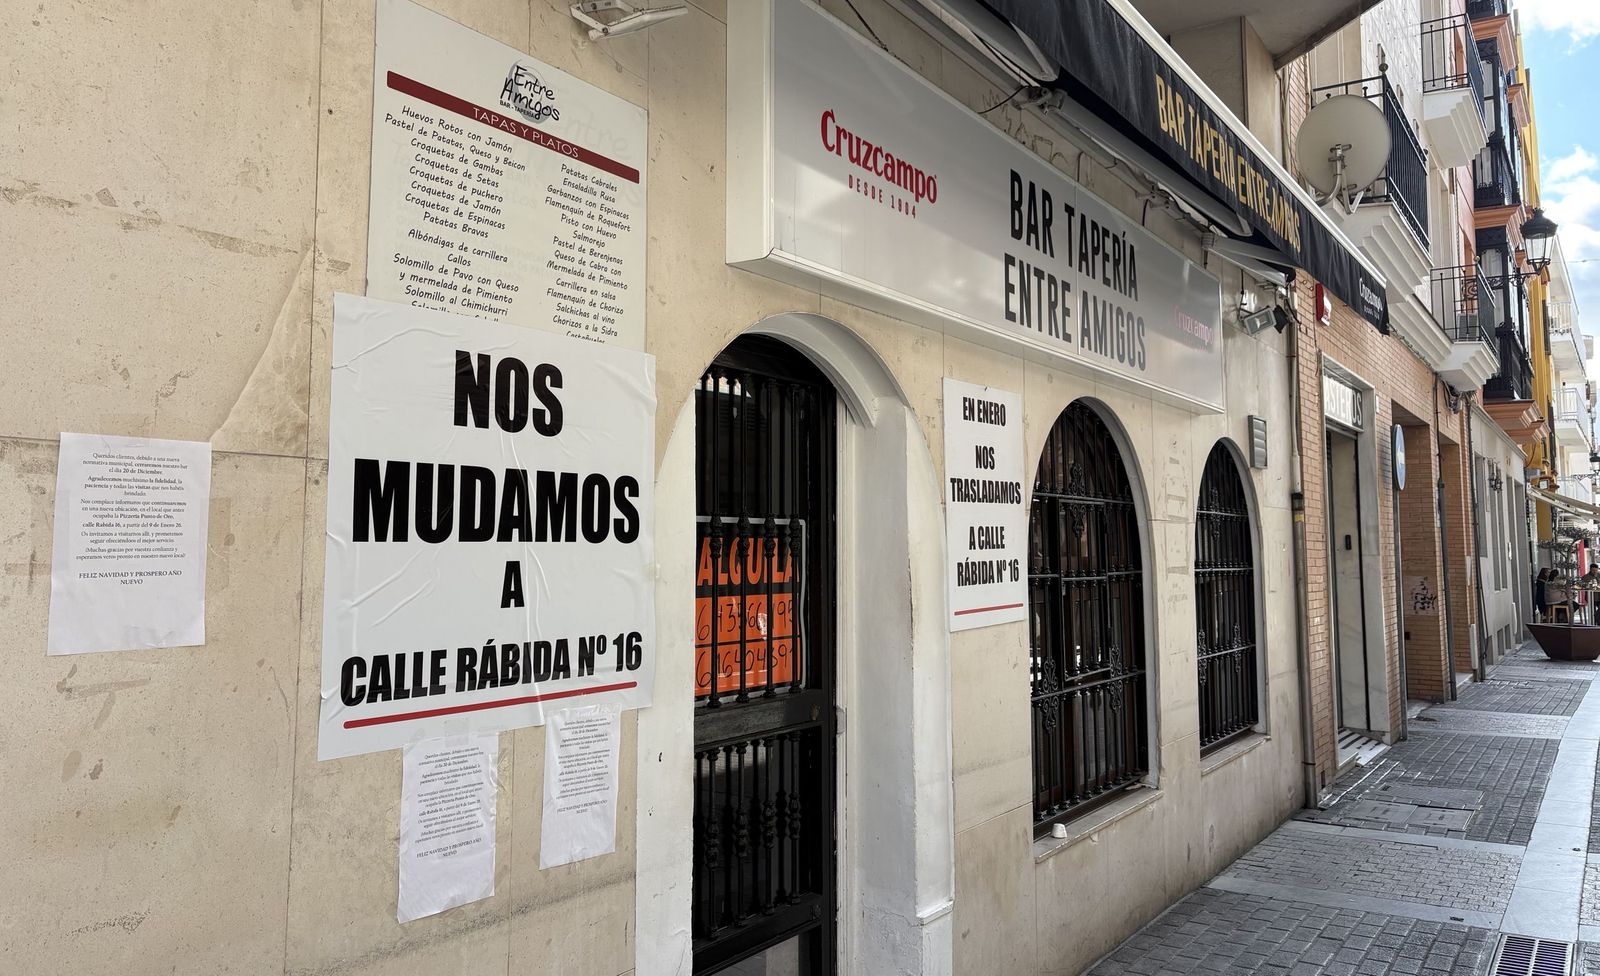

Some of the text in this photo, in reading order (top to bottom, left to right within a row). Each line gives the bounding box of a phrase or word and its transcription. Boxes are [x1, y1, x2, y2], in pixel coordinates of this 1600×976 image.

[514, 65, 555, 100] Entre
[500, 77, 560, 121] Amigos
[500, 100, 510, 108] BAR
[385, 114, 414, 131] Pastel
[418, 127, 427, 136] de
[432, 131, 464, 150] Patatas,
[470, 145, 491, 158] Queso
[503, 158, 525, 171] Beicon
[402, 106, 512, 153] Huevos Rotos con Jamón
[473, 107, 516, 134] TAPAS
[520, 126, 528, 137] Y
[532, 131, 580, 158] PLATOS
[411, 138, 503, 176] Croquetas de Gambas
[821, 109, 938, 204] Cruzcampo
[1156, 74, 1186, 152] BAR
[1238, 154, 1272, 224] ENTRE
[410, 166, 503, 202] Croquetas de puchero
[415, 154, 499, 188] Croquetas de Setas
[561, 164, 617, 192] Patatas Cabrales
[411, 181, 501, 215] Croquetas de Jamón
[547, 185, 629, 220] Garbanzos con Espinacas
[563, 178, 615, 203] Ensaladilla Rusa
[848, 174, 882, 204] DESDE
[405, 193, 505, 230] Croquetas de Espinacas
[423, 212, 488, 238] Patatas Bravas
[545, 197, 631, 232] Flamenquín de Roquefort
[561, 214, 616, 239] Pisto con Huevo
[408, 229, 508, 262] Albóndigas de carrillera
[553, 236, 623, 265] Pastel de Berenjenas
[573, 230, 605, 248] Salmorejo
[1010, 168, 1138, 301] BAR TAPERÍA
[393, 253, 519, 292] Solomillo de Pavo con Queso
[448, 254, 471, 266] Callos
[547, 260, 627, 290] Mermelada de Pimiento
[555, 250, 621, 276] Queso de Cabra con
[400, 272, 512, 304] y mermelada de Pimiento
[405, 285, 444, 302] Solomillo
[449, 296, 457, 304] al
[461, 299, 508, 316] Chimichurri
[547, 288, 624, 315] Flamenquín de Chorizo
[556, 278, 587, 292] Carrillera
[601, 291, 616, 300] salsa
[553, 315, 582, 329] Chorizos
[592, 324, 598, 332] la
[601, 326, 617, 336] Sidra
[556, 303, 590, 319] Salchichas
[602, 316, 615, 325] vino
[1004, 252, 1146, 372] ENTRE AMIGOS
[454, 350, 563, 436] NOS
[962, 396, 1006, 427] EN ENERO
[976, 445, 995, 470] NOS
[352, 458, 640, 544] MUDAMOS
[950, 478, 1021, 505] TRASLADAMOS
[969, 526, 1005, 550] A CALLE
[500, 560, 524, 608] A
[957, 557, 1019, 587] RÁBIDA Nº 16
[340, 631, 643, 706] CALLE RÁBIDA Nº 16
